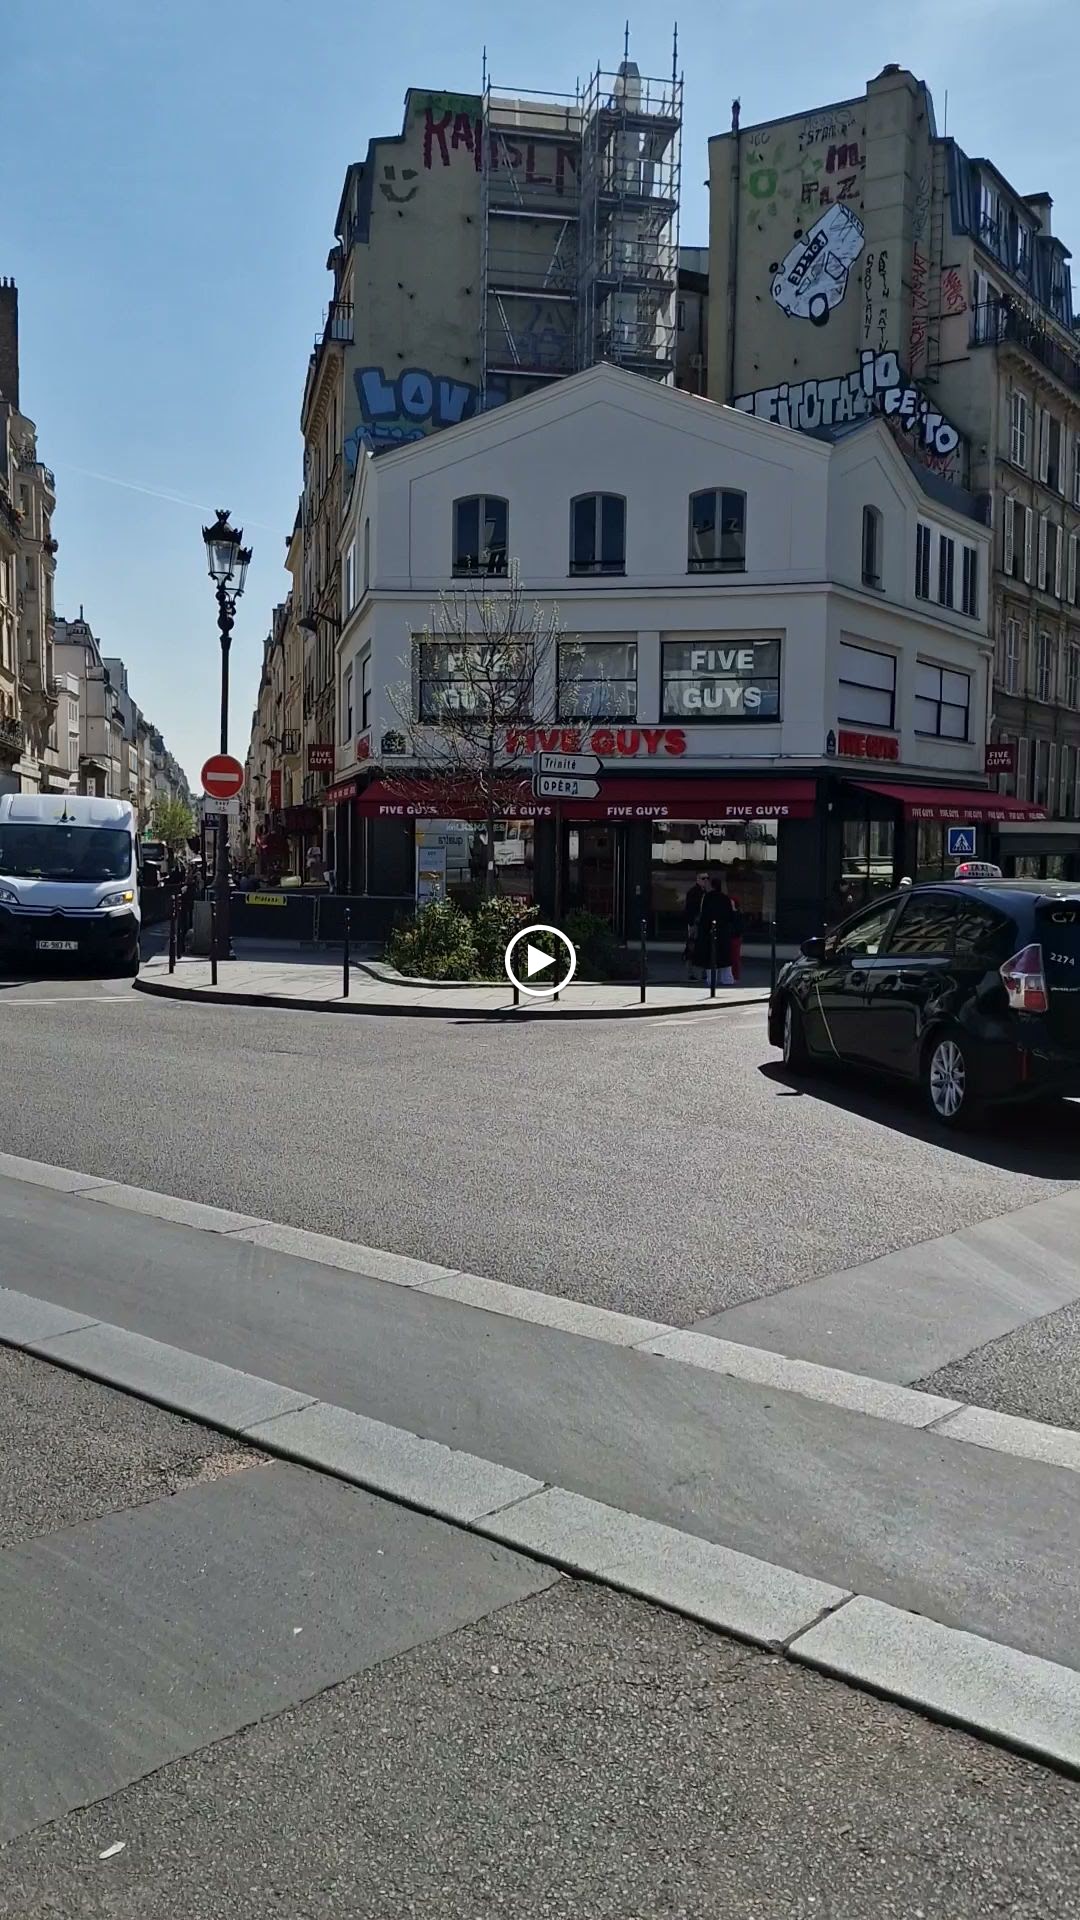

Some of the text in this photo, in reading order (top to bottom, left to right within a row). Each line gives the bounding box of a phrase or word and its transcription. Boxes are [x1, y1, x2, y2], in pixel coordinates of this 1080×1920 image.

[691, 650, 755, 671] FIVE
[682, 686, 762, 708] GUYS
[505, 729, 686, 756] FIVE GUYS
[311, 750, 331, 758] FIVE
[989, 751, 1009, 759] FIVE
[309, 757, 333, 765] GUYS
[545, 757, 576, 770] Trinité
[986, 757, 1012, 766] GUYS
[379, 804, 437, 815] FIVE GUYS
[520, 806, 551, 816] GUYS
[607, 806, 669, 816] FIVE GUYS
[725, 806, 789, 815] FIVE GUYS
[700, 827, 726, 836] OPEN
[1051, 911, 1077, 923] G7
[1049, 951, 1075, 967] 2274
